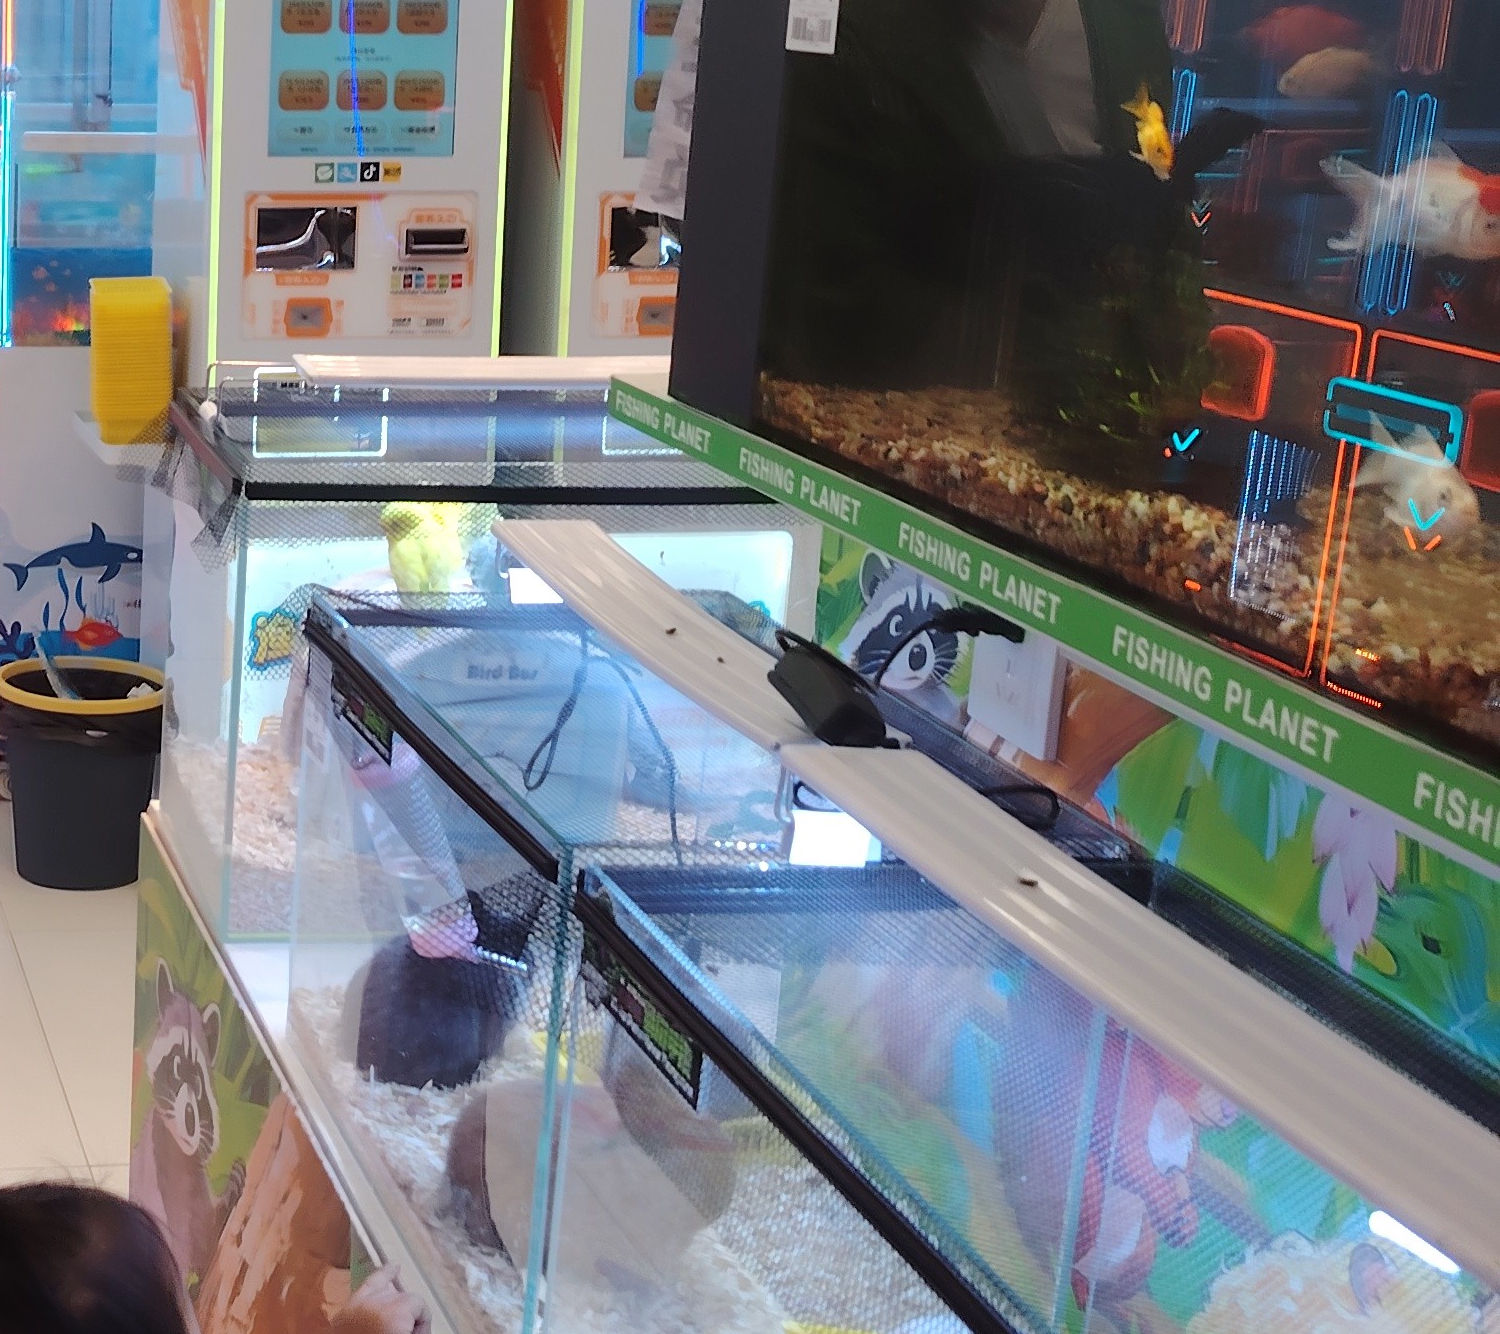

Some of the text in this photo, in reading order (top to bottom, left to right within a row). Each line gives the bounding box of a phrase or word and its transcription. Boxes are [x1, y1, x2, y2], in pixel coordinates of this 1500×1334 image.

[615, 389, 712, 454] FISHING PLANET
[738, 447, 862, 526] FISHING PLANET
[898, 521, 1063, 626] FISHING PLANET
[1111, 624, 1340, 764] FISHING PLANET
